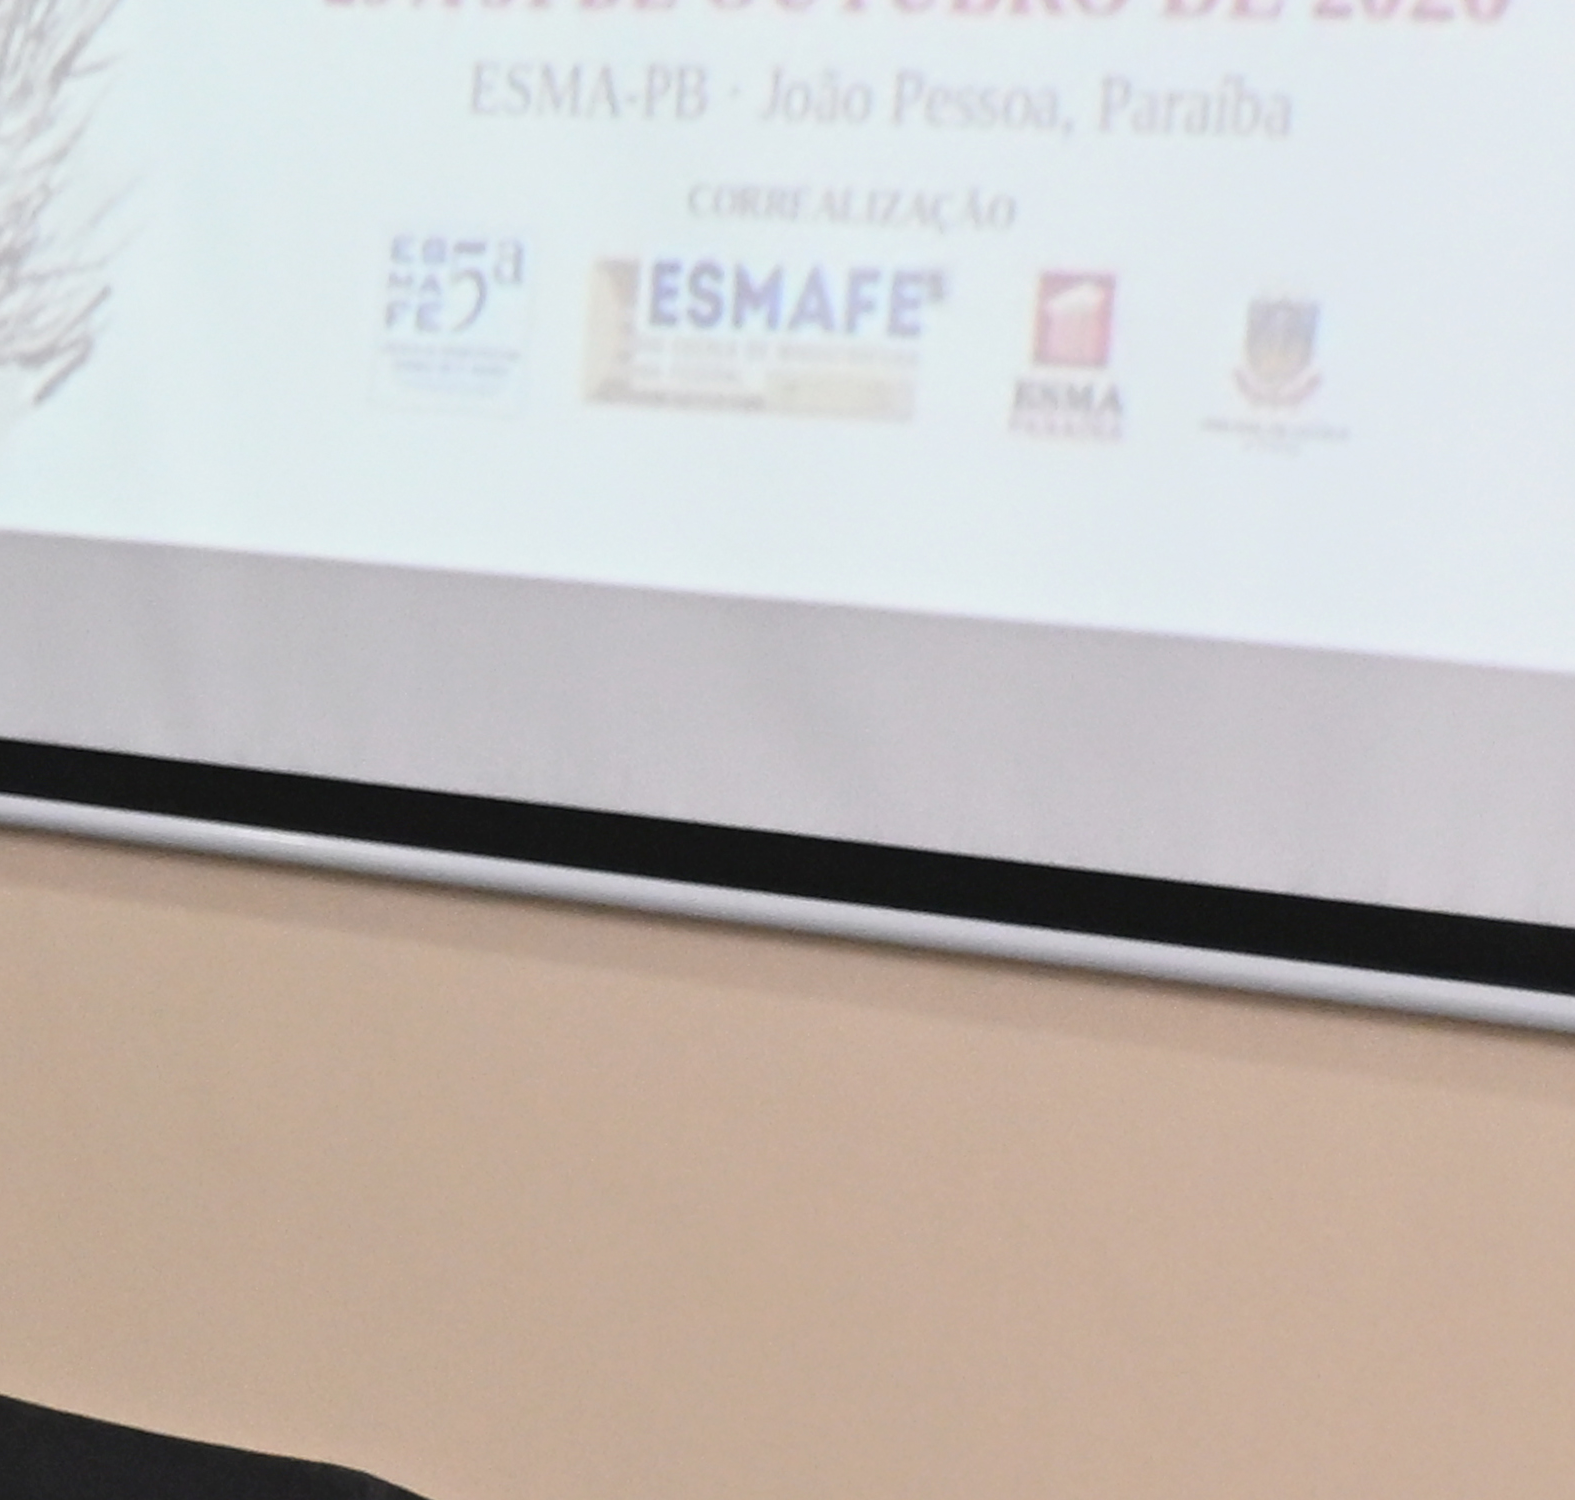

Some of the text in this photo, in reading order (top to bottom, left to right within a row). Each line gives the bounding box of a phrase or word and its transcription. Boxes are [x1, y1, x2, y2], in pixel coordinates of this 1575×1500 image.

[469, 62, 1294, 139] ESMA-PB João Pessoa, Paraíba
[687, 182, 1018, 235] CORREALIZAÇÃO
